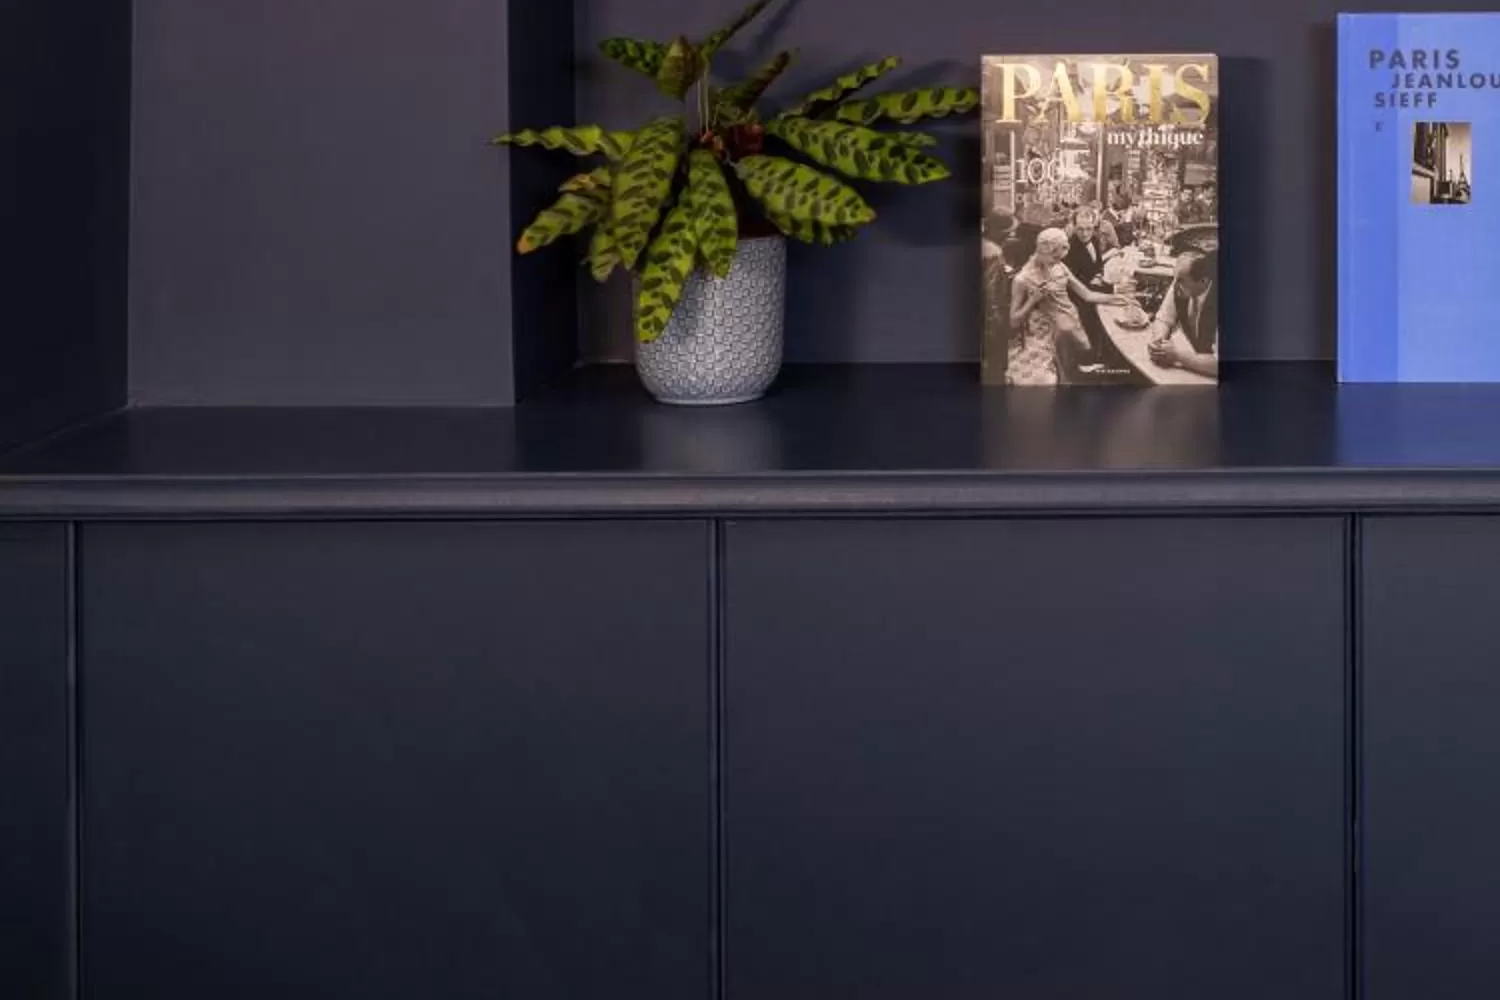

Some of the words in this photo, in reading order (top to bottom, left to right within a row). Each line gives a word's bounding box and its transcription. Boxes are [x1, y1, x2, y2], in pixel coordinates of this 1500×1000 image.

[1370, 49, 1460, 69] PARIS
[994, 62, 1211, 127] PARIS
[1374, 92, 1438, 108] SIEFF
[1107, 124, 1204, 148] mythique
